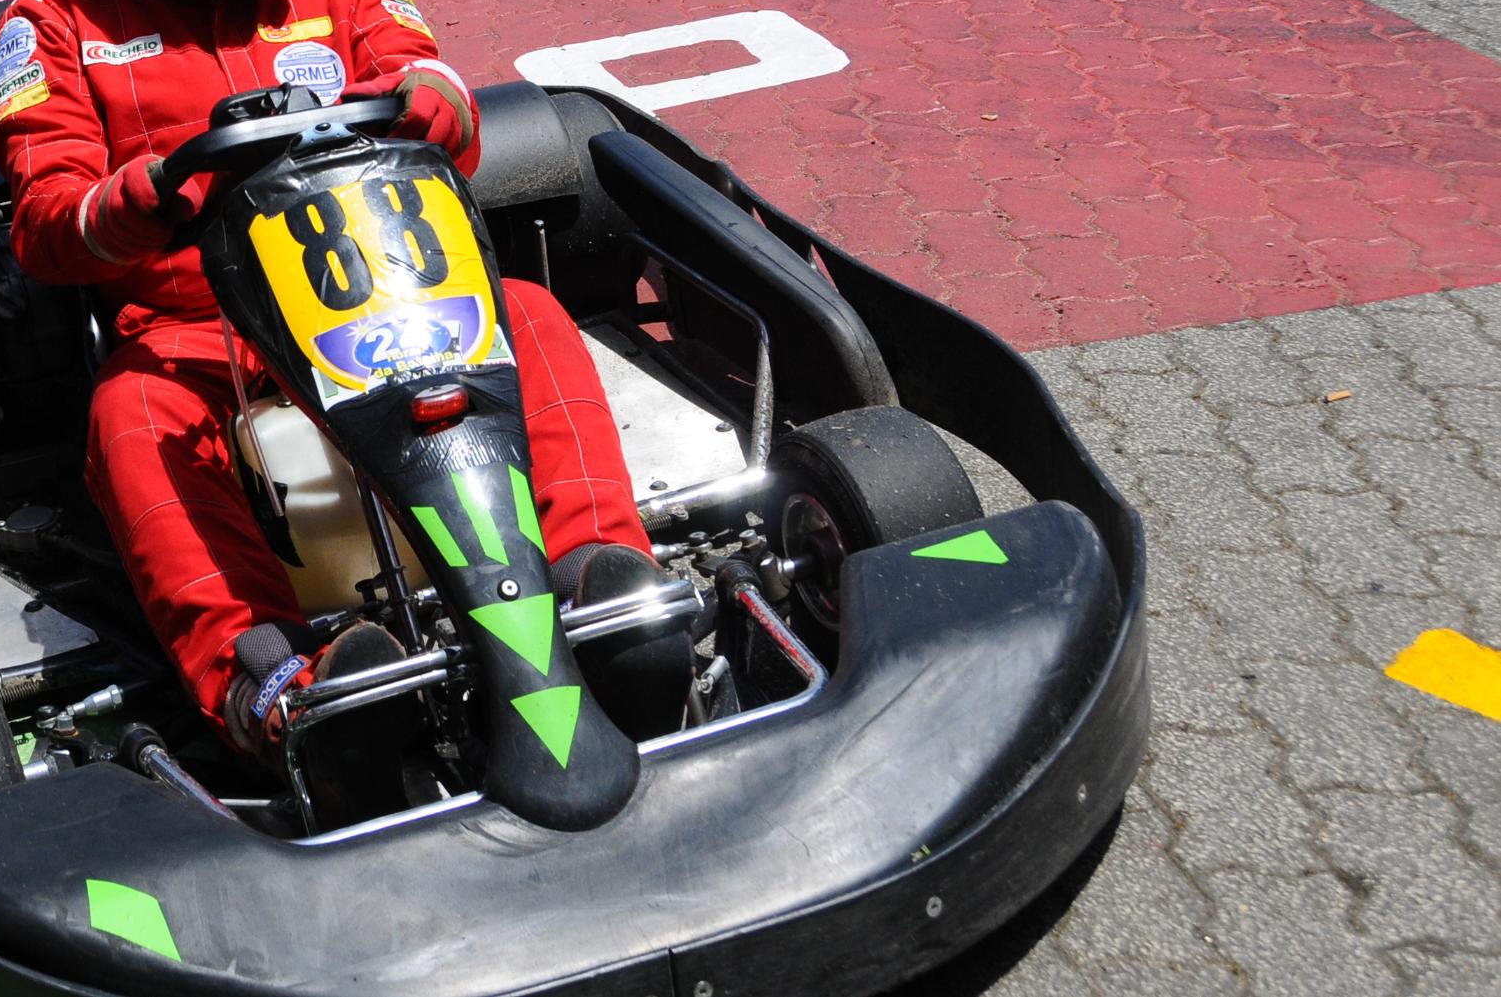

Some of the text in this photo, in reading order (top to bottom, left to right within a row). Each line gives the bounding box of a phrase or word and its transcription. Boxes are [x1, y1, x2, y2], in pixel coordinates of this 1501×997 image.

[103, 41, 158, 59] RECHEIO
[285, 178, 449, 312] 88
[374, 366, 393, 379] da
[256, 659, 300, 712] sparco
